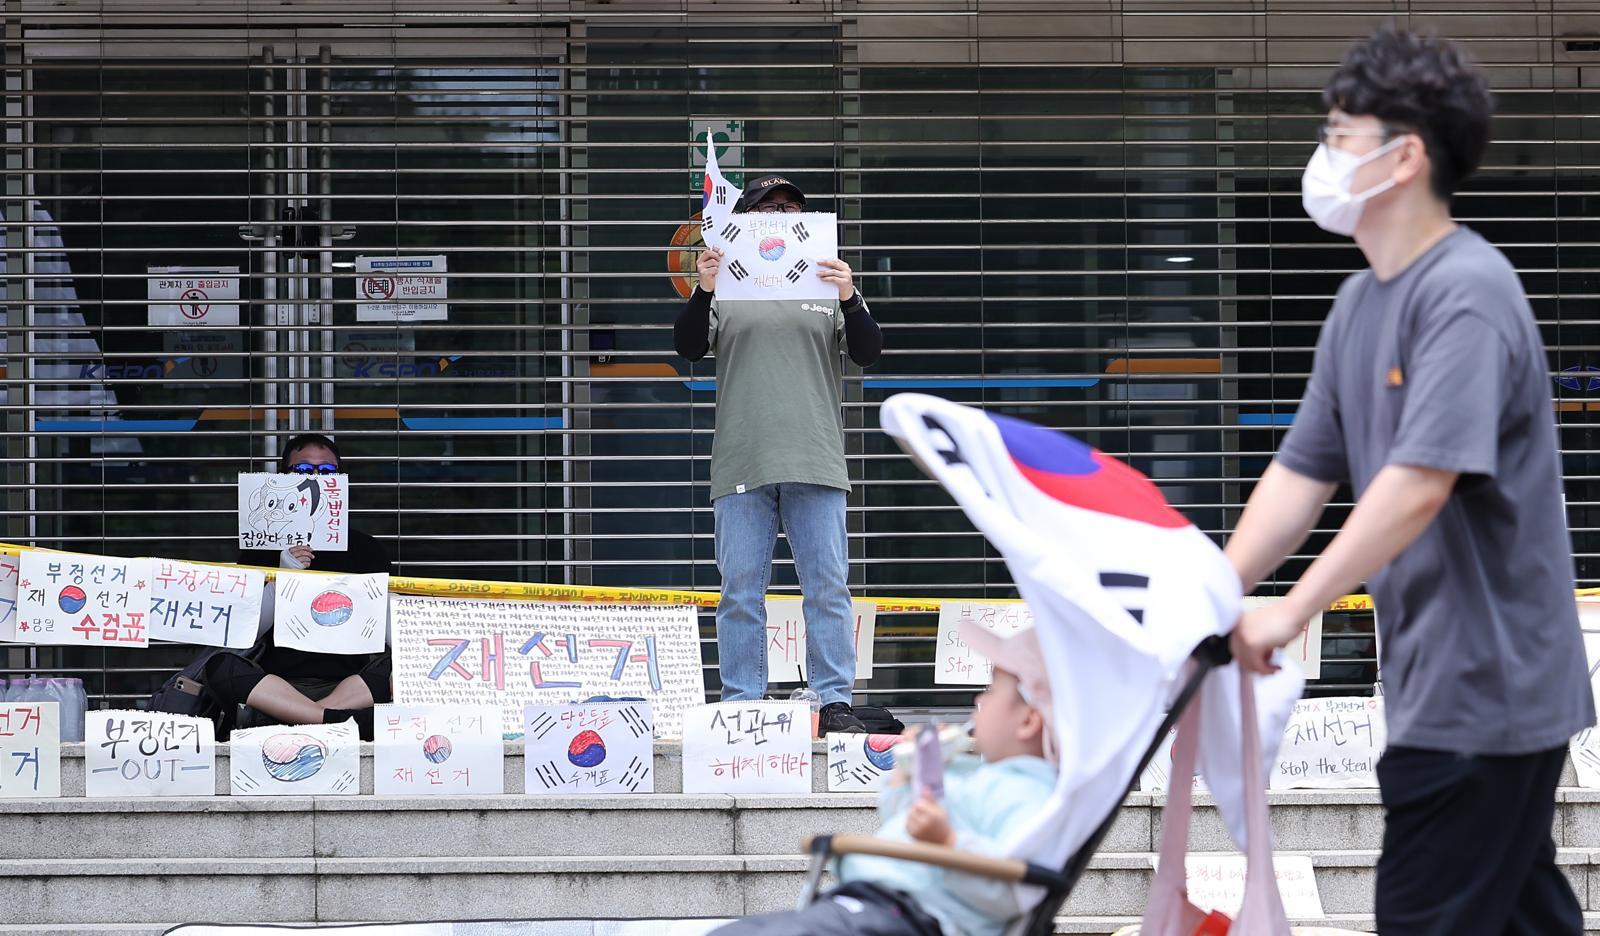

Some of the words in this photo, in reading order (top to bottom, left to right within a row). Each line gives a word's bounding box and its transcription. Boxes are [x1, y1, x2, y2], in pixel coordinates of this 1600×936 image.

[747, 219, 788, 238] 부정선거
[159, 280, 182, 289] 관계자
[186, 280, 194, 289] 외
[197, 280, 229, 289] 출입금지
[402, 286, 436, 295] 반입금지
[753, 273, 783, 288] 재선거
[809, 303, 834, 316] Jeep
[323, 478, 343, 544] 불법선거
[46, 562, 127, 585] 부정선거
[155, 563, 249, 598] 부정선거
[396, 599, 438, 609] 재선거
[440, 600, 479, 610] 재선거
[481, 601, 517, 611] 재선거
[520, 602, 556, 612] 재선거
[560, 603, 592, 612] 재선거
[594, 604, 626, 612] 재선거
[630, 604, 663, 612] 재선거
[32, 618, 55, 632] 당일
[71, 612, 147, 643] 수검표
[150, 597, 233, 647] 재선거
[427, 632, 661, 691] 재선거
[945, 657, 973, 680] Stop
[100, 718, 201, 759] 부정선거
[710, 709, 794, 745] 선관위
[1285, 713, 1373, 747] 재선거
[1316, 758, 1341, 773] the
